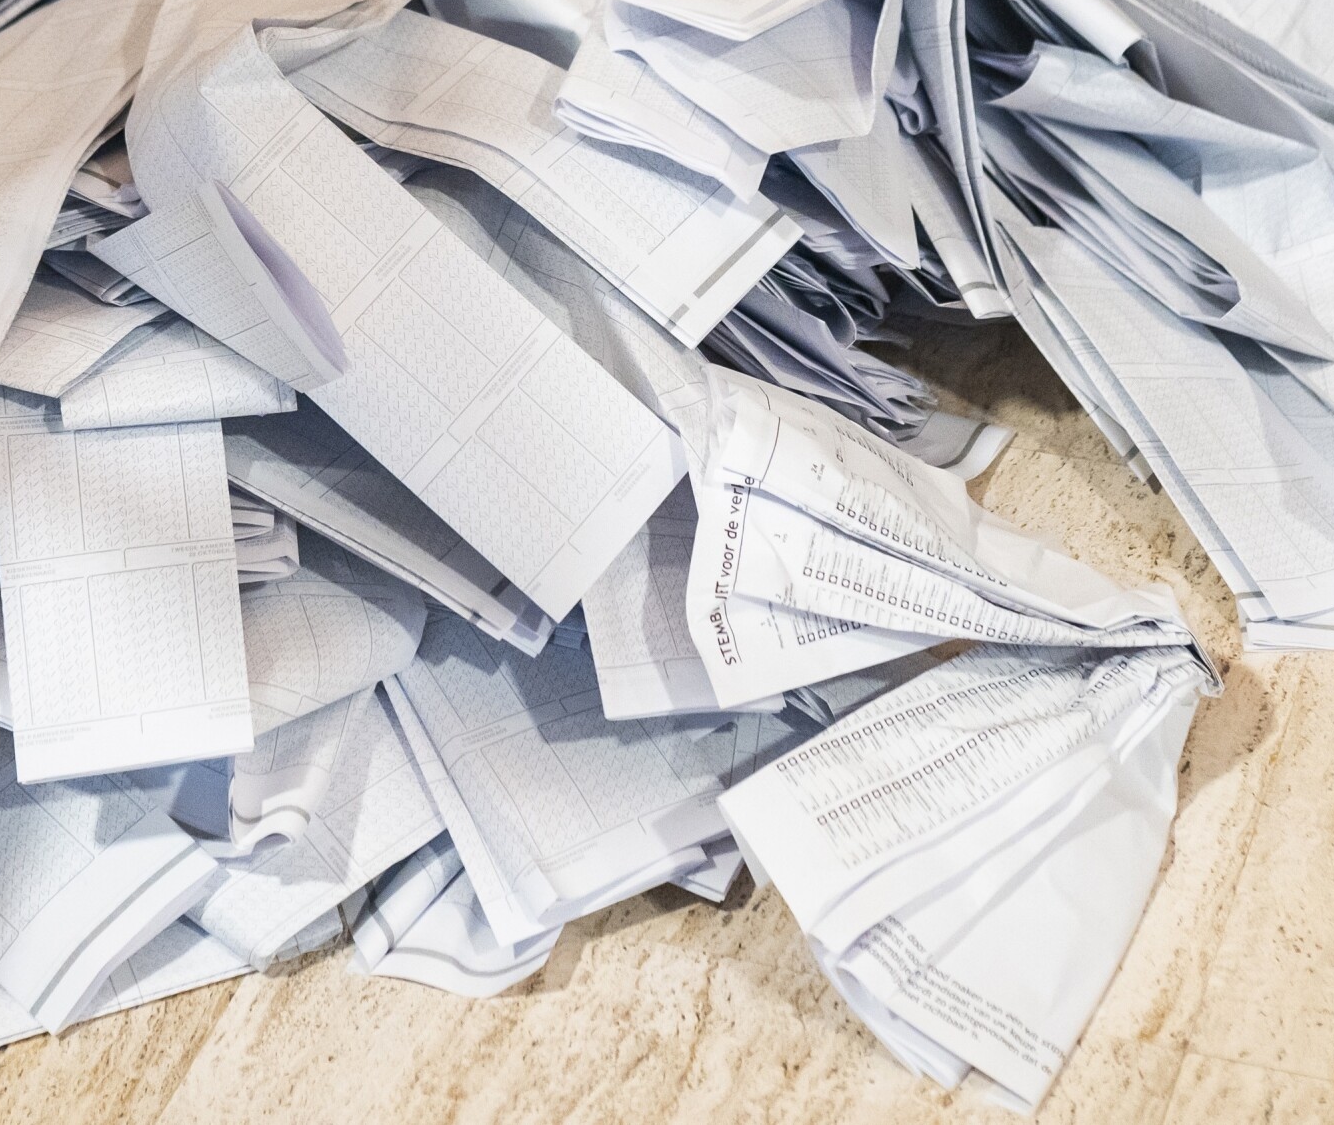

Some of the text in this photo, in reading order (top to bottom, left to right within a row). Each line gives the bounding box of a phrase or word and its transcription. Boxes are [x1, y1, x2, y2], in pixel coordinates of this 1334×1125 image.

[725, 520, 739, 539] de
[720, 543, 735, 578] voor
[923, 972, 971, 1009] kandidaat
[973, 1005, 991, 1020] van
[992, 1017, 1008, 1031] uw
[952, 980, 984, 1003] maken
[986, 1000, 1003, 1015] van
[922, 999, 968, 1033] zichtbaar
[1021, 1052, 1039, 1067] dat
